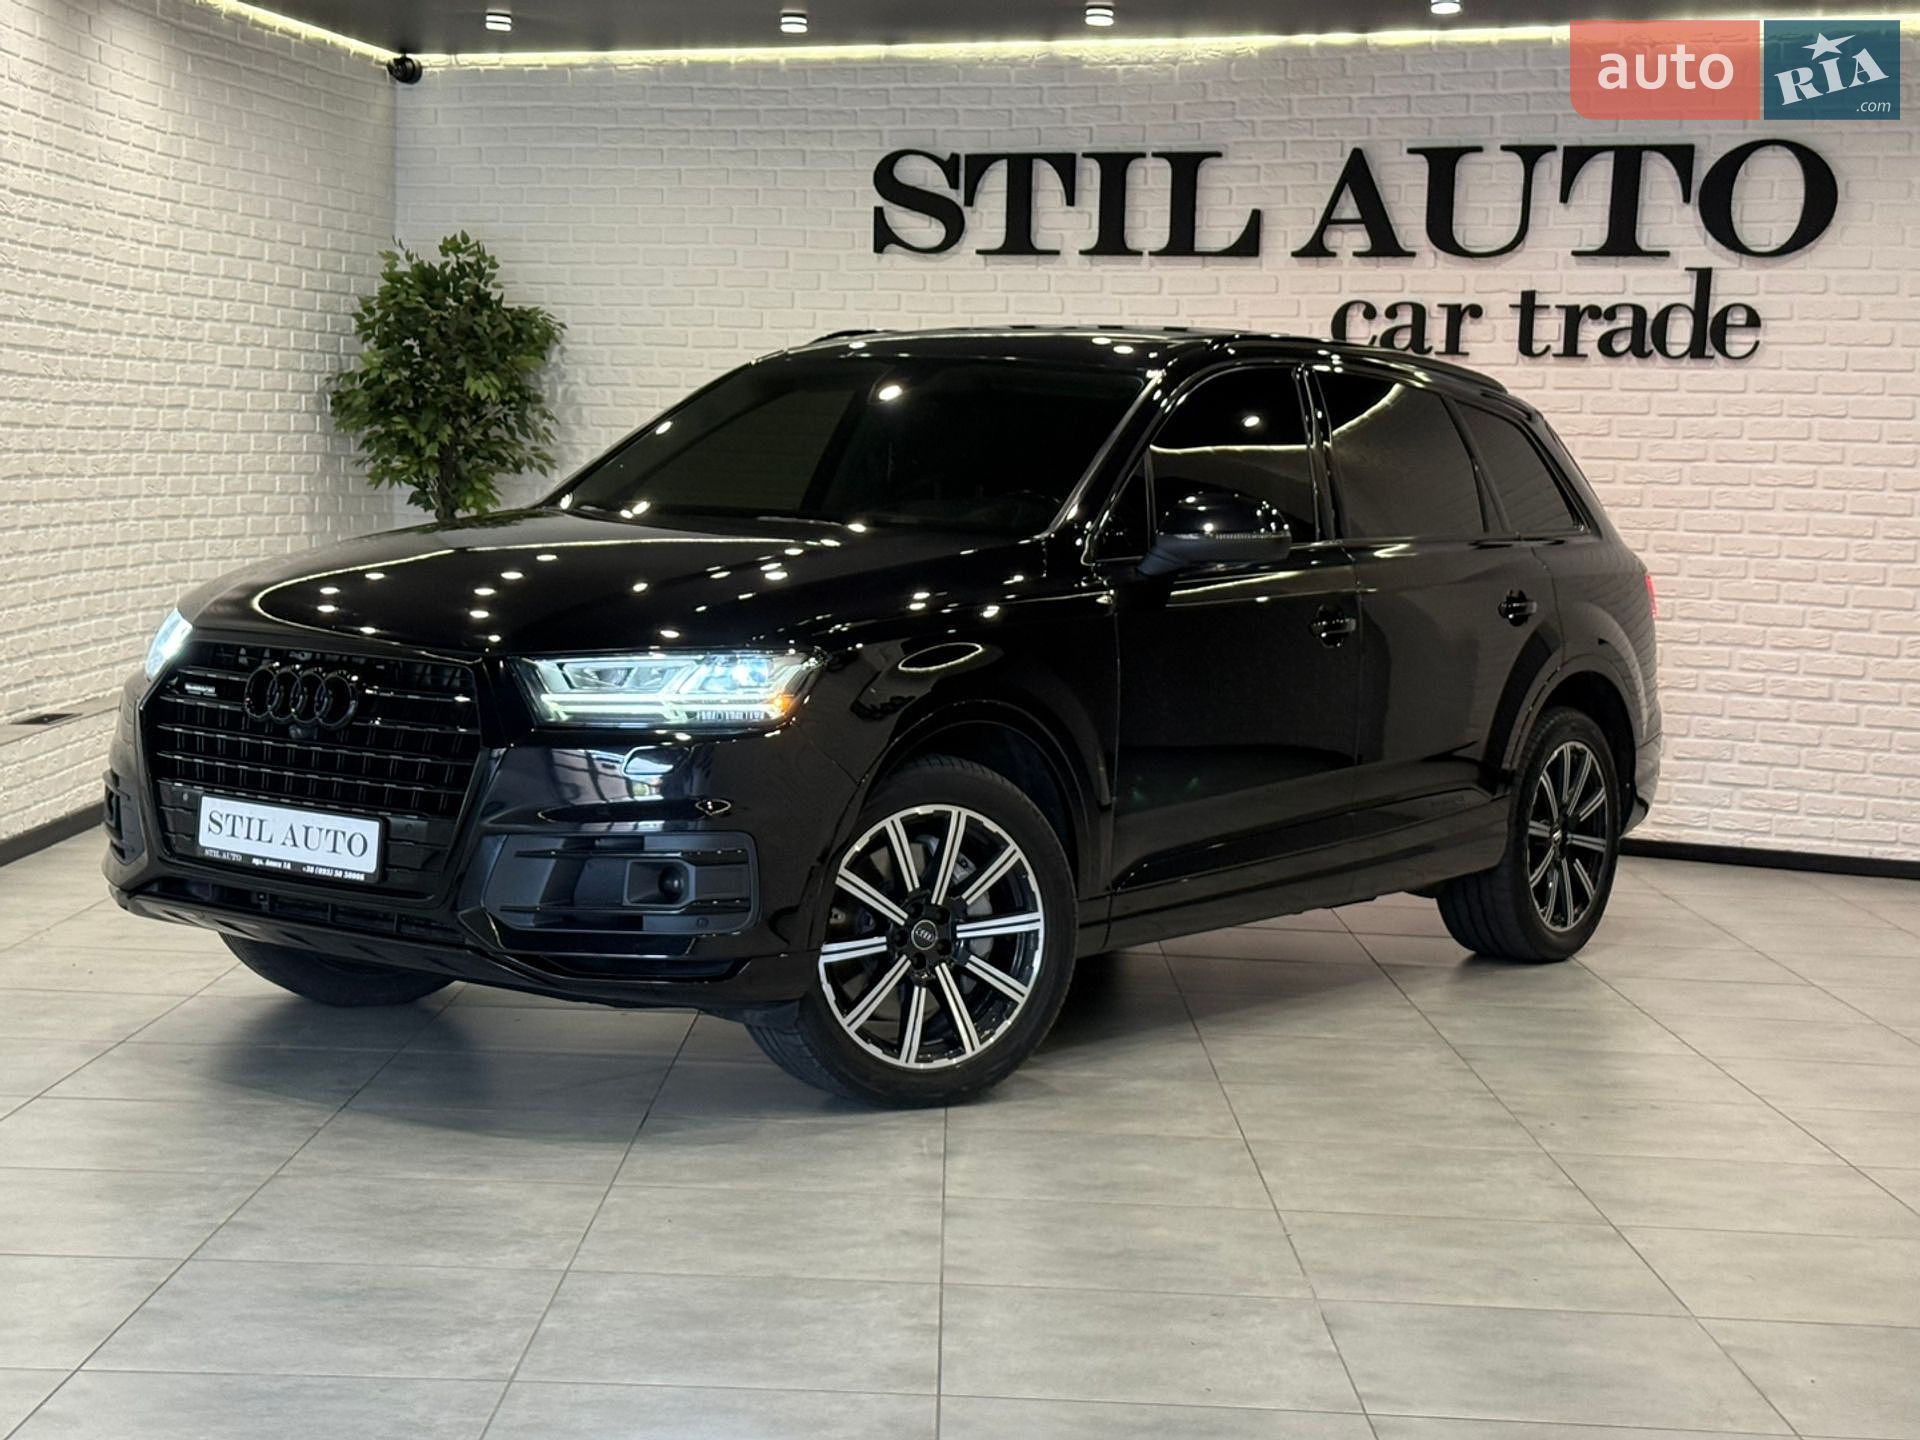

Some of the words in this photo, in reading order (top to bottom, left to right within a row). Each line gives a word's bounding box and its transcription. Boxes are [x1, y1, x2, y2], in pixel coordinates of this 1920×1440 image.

[873, 149, 1262, 258] STIL
[1291, 138, 1839, 259] AUTO
[1330, 299, 1484, 356] car
[1509, 267, 1762, 360] trade
[207, 810, 273, 844] STIL
[281, 823, 368, 858] AUTO
[221, 850, 243, 863] AUTO
